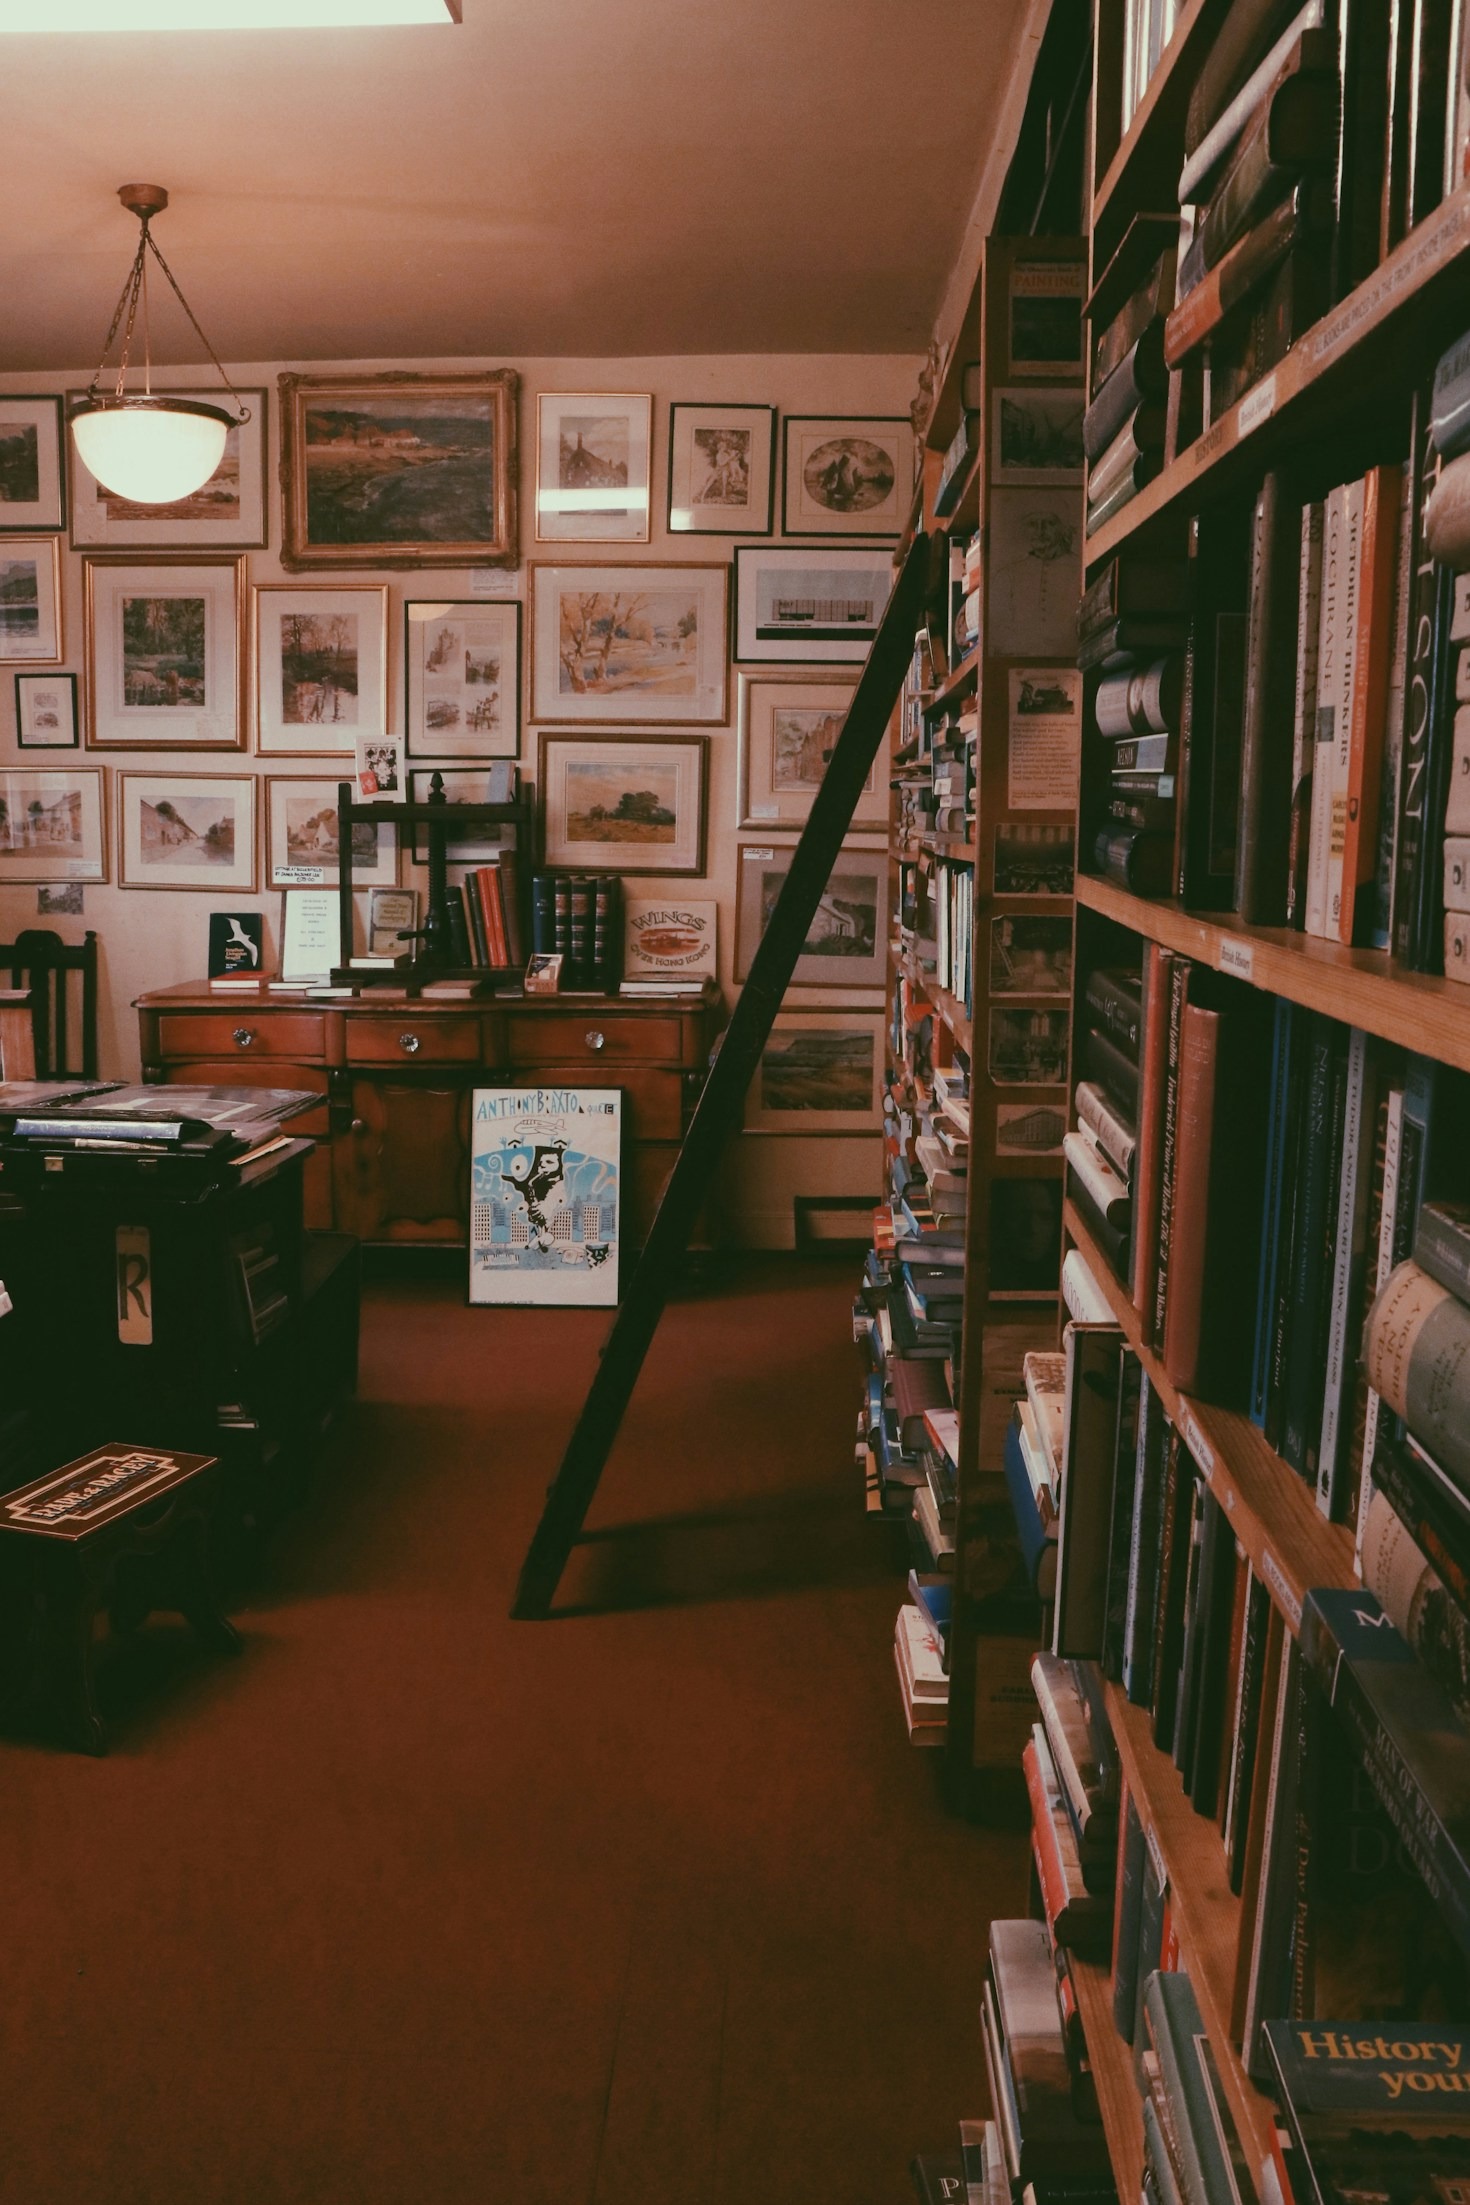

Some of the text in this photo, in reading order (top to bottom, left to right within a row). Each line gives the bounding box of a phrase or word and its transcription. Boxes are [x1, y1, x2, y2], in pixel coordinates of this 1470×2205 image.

[1015, 275, 1079, 287] PAINTING
[1324, 511, 1339, 690] COCHRANE
[1340, 511, 1359, 767] VICTORIAN THINKERS
[631, 911, 707, 931] WINGS
[631, 943, 711, 967] OVER HONG KONG
[1352, 1046, 1360, 1077] THE
[477, 1095, 536, 1120] ANTHONY
[1165, 1075, 1177, 1131] Frederick
[1315, 1047, 1329, 1134] NELSON
[1349, 1085, 1358, 1144] TUDOR
[1162, 1132, 1174, 1170] Prince
[1346, 1152, 1355, 1186] AND
[1341, 1191, 1352, 1255] STUART
[119, 1253, 150, 1320] R
[1157, 1268, 1167, 1293] John
[1380, 1255, 1388, 1283] Eas
[1376, 1270, 1422, 1391] OPULATION
[1386, 1330, 1397, 1354] IN
[1392, 1303, 1421, 1399] HISTORY
[31, 1492, 87, 1517] RARE
[1361, 1464, 1371, 1533] COOGAN
[1351, 1608, 1396, 1629] M
[1374, 1722, 1439, 1849] MAN OF WAR
[1295, 1900, 1311, 2021] Parliamen
[1297, 2032, 1462, 2067] History
